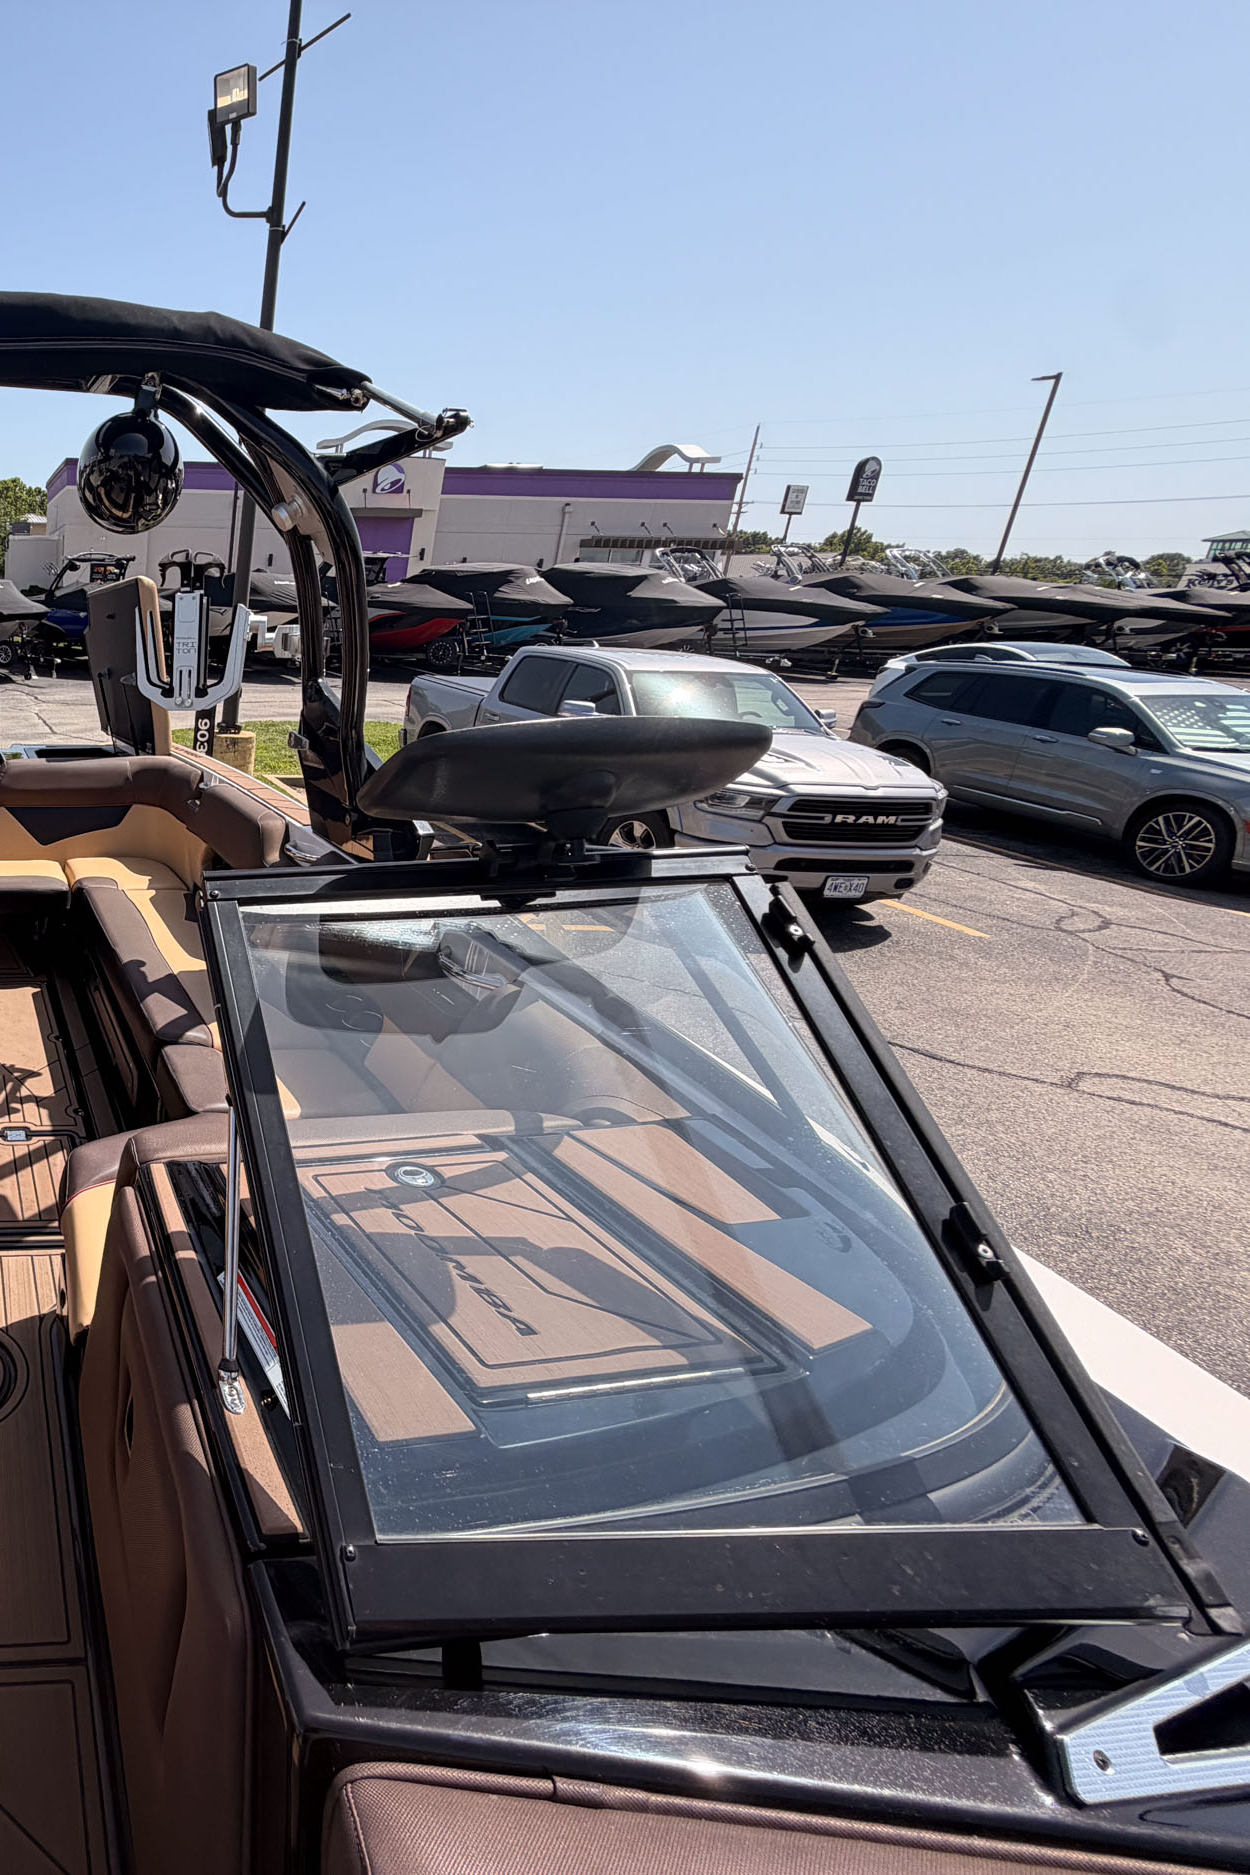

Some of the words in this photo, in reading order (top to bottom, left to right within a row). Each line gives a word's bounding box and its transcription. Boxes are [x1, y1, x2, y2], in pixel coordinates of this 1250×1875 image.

[859, 478, 877, 486] TACO
[857, 485, 873, 493] BELL
[834, 814, 898, 825] RAM
[363, 1187, 539, 1337] MOOMBA
